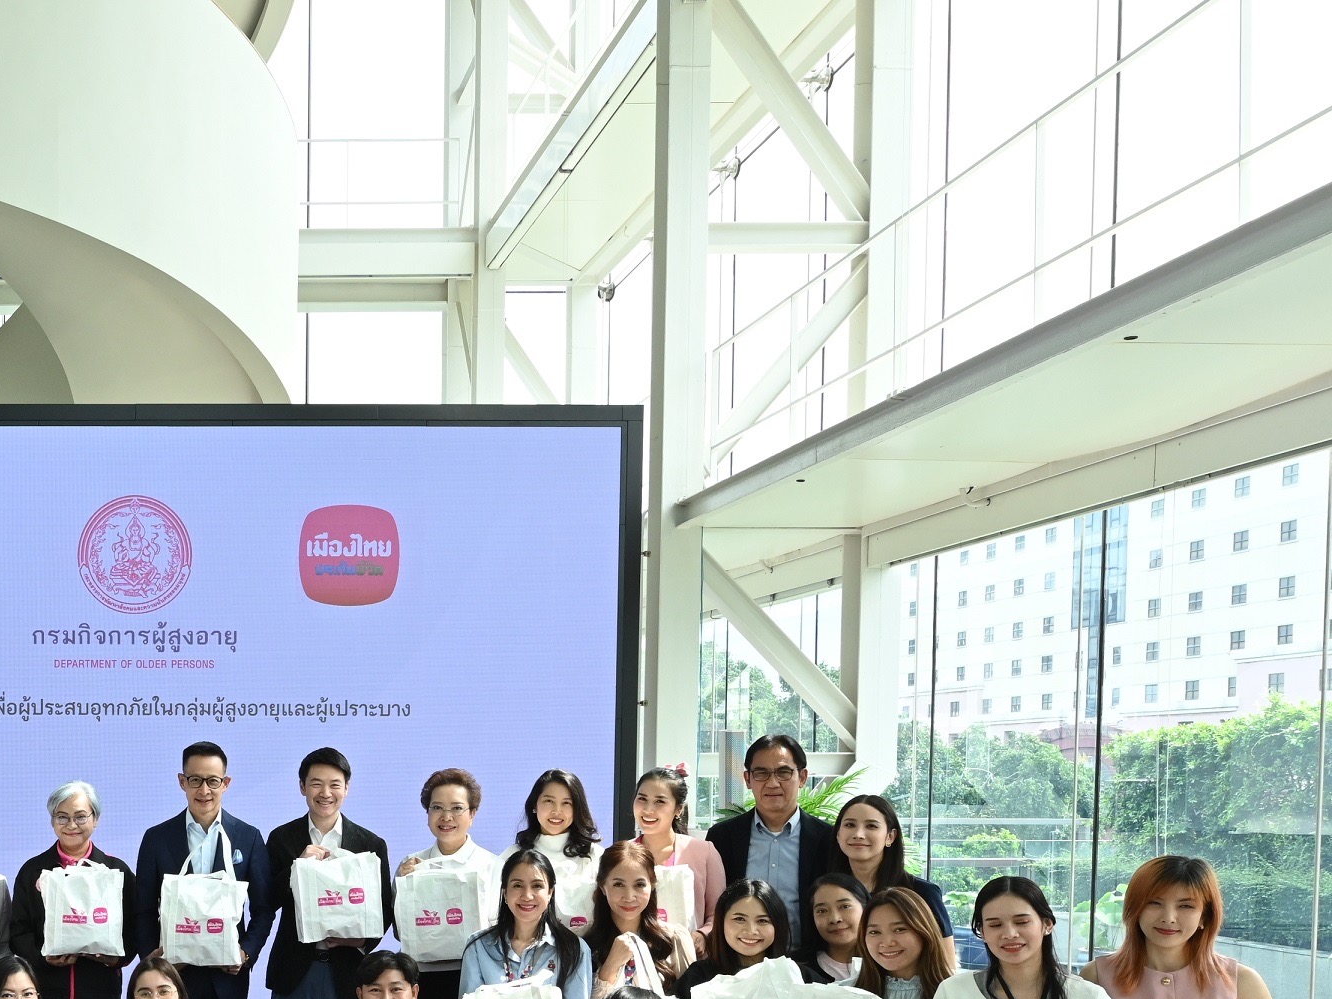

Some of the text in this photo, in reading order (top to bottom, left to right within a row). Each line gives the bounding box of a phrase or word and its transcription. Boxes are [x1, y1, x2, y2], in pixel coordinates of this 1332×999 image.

[306, 531, 392, 557] เมืองไทย
[31, 621, 239, 653] กรมกิจการผู้สูงอายุ
[53, 659, 215, 669] DEPARTMENT OF OLDER PERSONS
